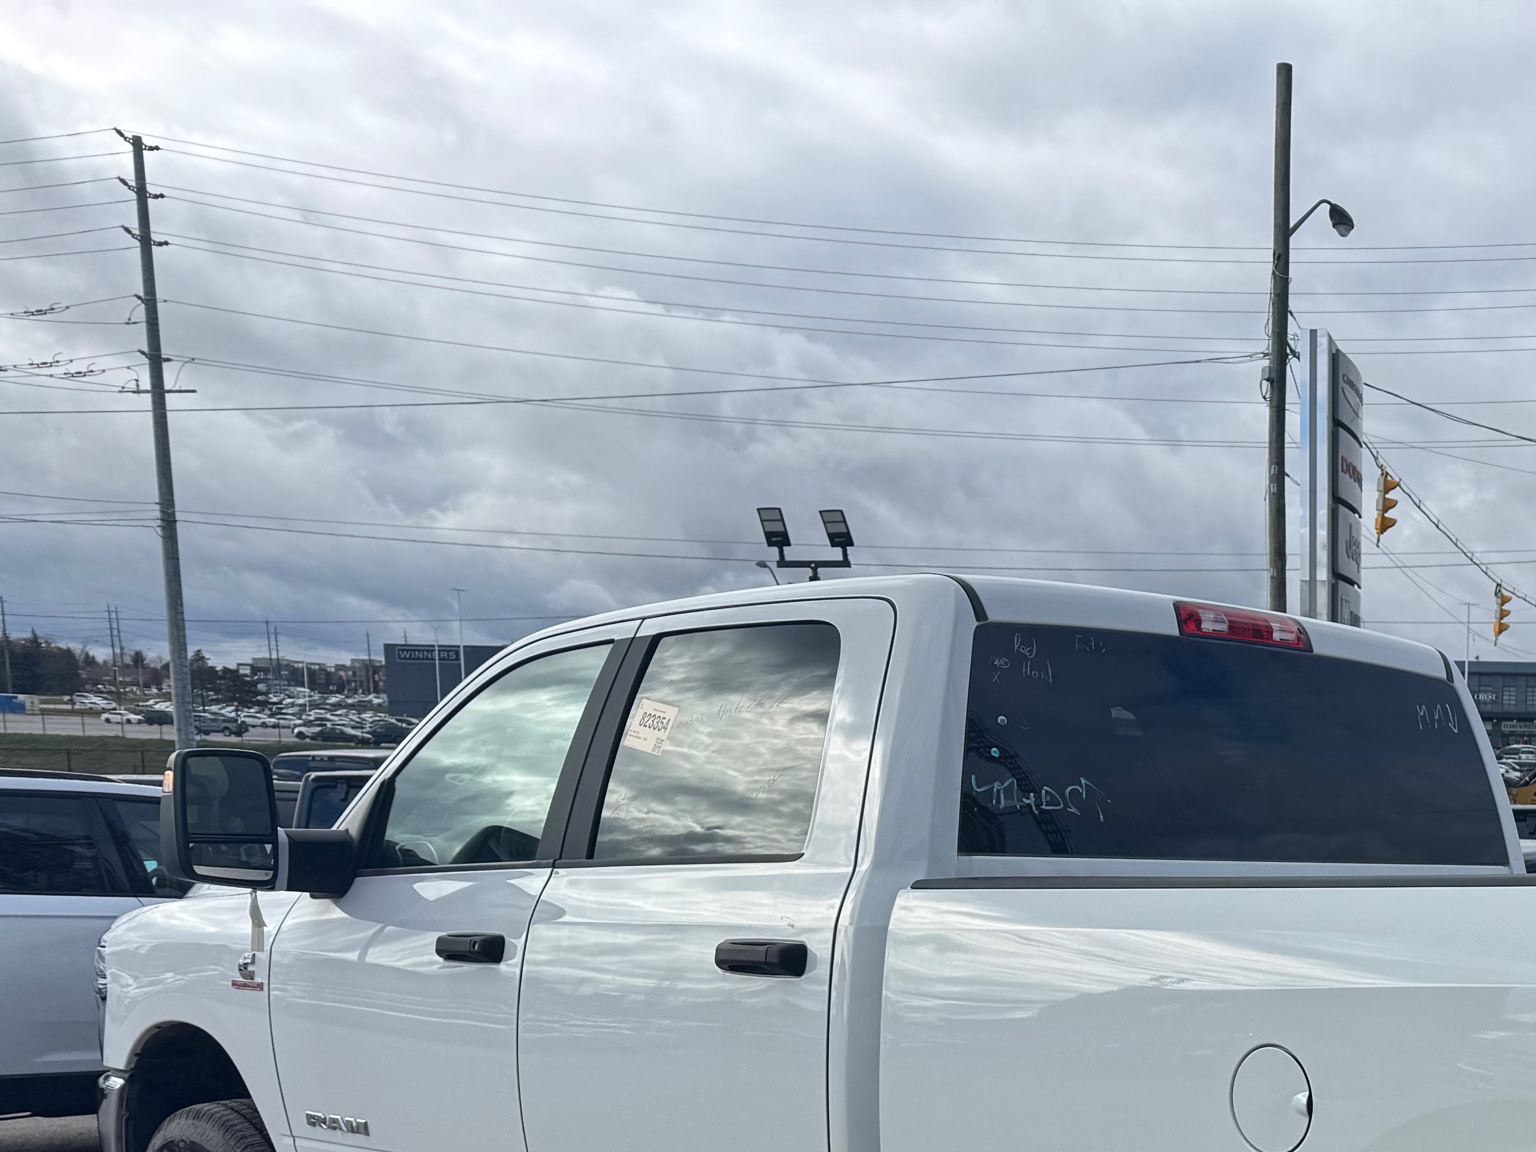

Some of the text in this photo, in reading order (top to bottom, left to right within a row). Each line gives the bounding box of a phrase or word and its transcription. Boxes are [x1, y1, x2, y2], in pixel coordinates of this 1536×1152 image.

[398, 650, 457, 660] WINNERS
[638, 711, 671, 733] 823354
[305, 1110, 370, 1137] RAM
